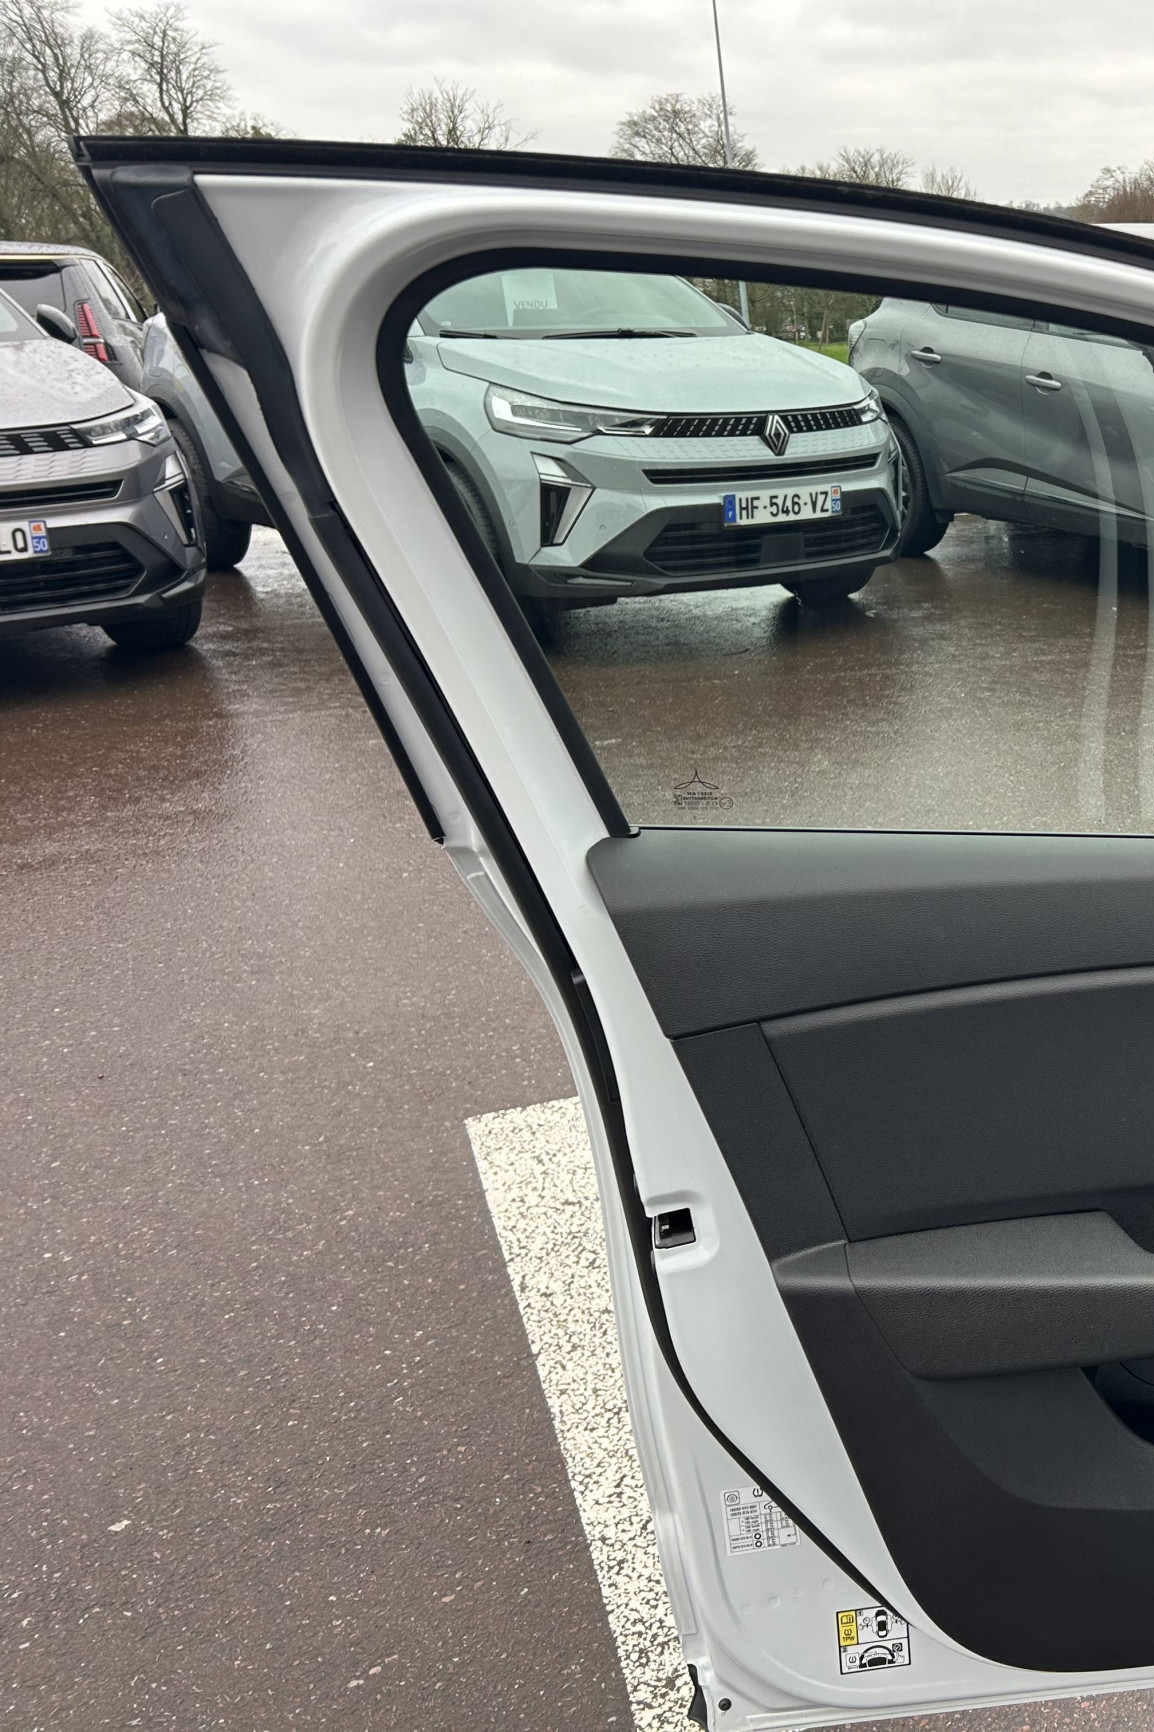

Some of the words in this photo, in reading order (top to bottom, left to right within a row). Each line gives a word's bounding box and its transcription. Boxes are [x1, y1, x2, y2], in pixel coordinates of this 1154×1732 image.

[514, 300, 548, 310] VENDU
[739, 491, 829, 520] HF-546-VZ
[831, 500, 841, 512] 50
[0, 528, 28, 554] Q
[32, 538, 48, 551] 50
